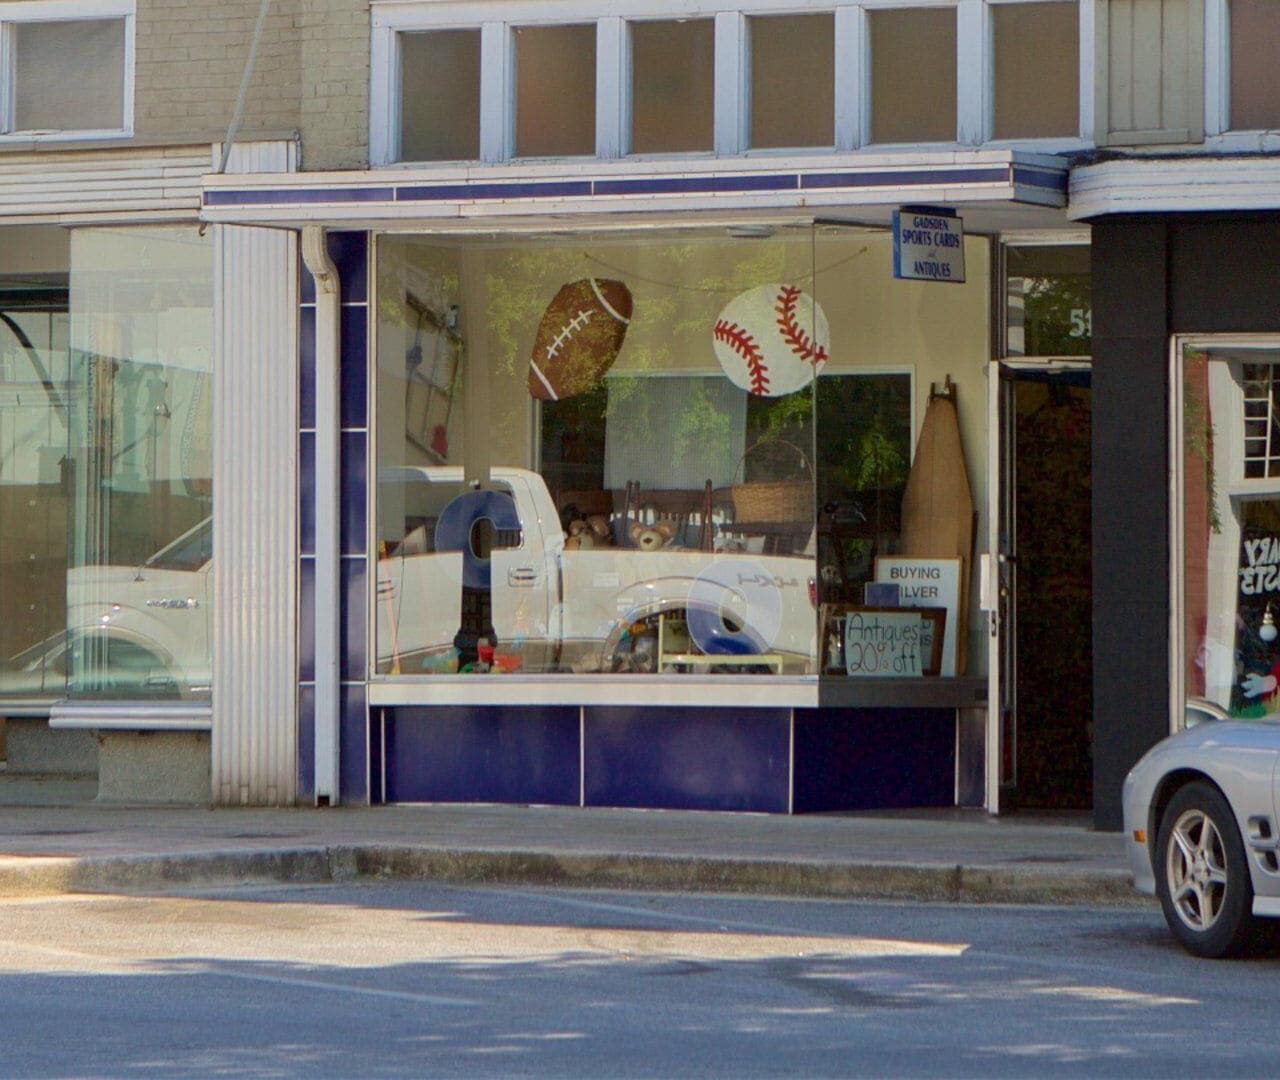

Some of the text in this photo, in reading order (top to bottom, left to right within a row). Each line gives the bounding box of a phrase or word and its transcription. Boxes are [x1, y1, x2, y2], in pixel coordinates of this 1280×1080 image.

[902, 229, 960, 248] SPORTS CARDS
[914, 261, 951, 279] ANTIQUES
[890, 567, 940, 579] BUYING
[900, 586, 938, 598] ILVER
[848, 613, 919, 651] Antiques
[893, 642, 917, 673] off
